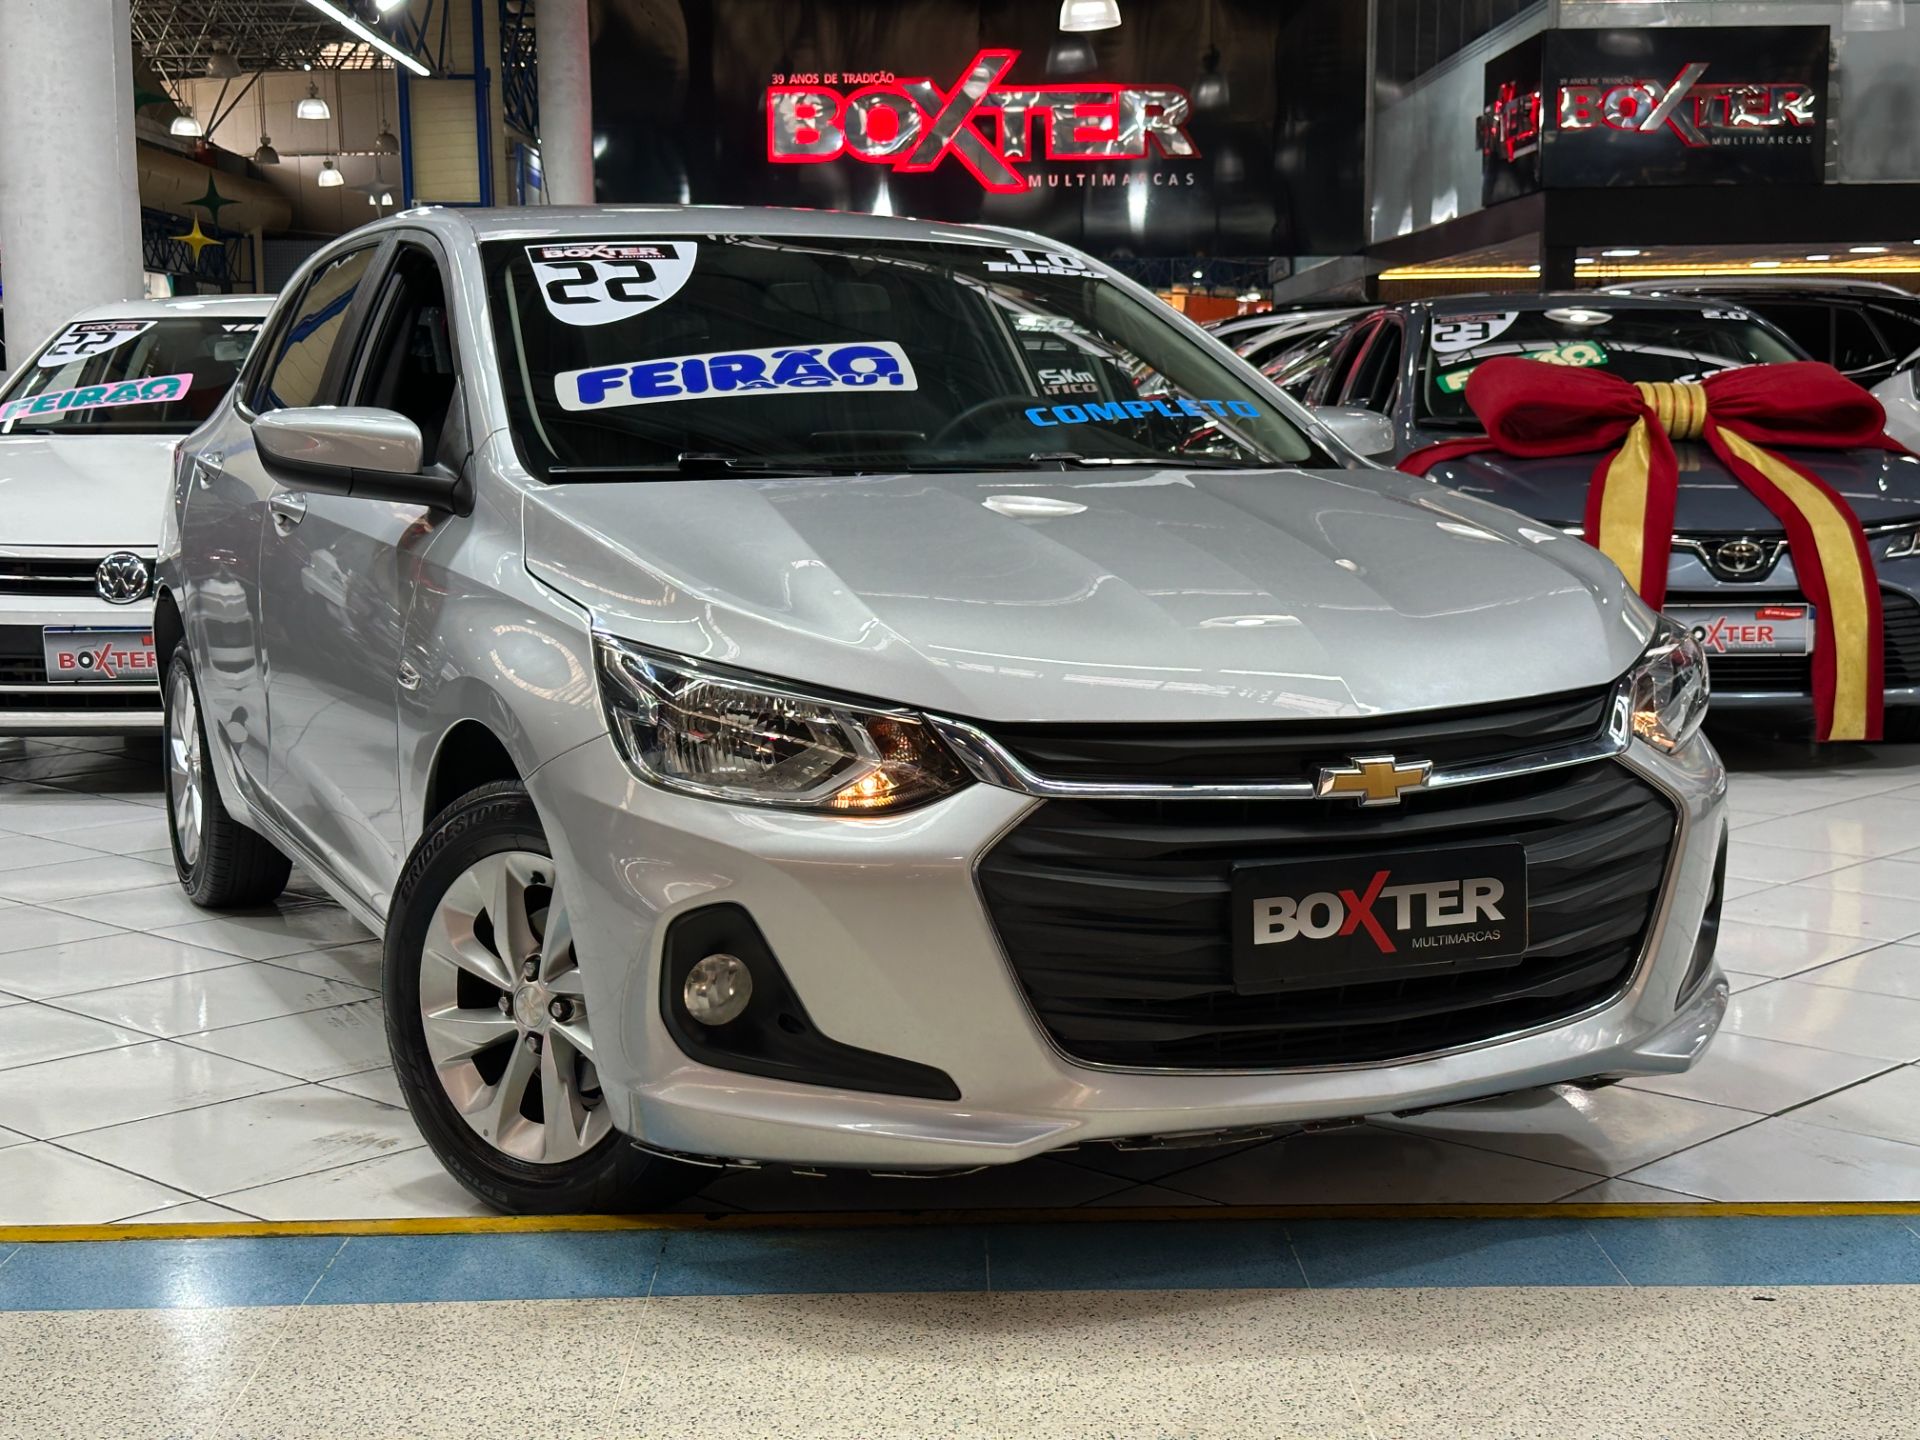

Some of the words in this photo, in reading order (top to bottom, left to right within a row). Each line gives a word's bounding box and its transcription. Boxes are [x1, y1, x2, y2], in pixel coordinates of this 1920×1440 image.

[772, 73, 785, 85] 39
[789, 73, 819, 85] ANOS
[824, 73, 838, 85] DE
[842, 70, 895, 86] TRADIÇÃO
[1557, 62, 1816, 147] BOXTER
[767, 48, 1202, 194] BOXTER
[1711, 135, 1813, 146] MULTIMARCAS
[1028, 173, 1196, 188] MULTIMARCAS
[542, 245, 662, 259] BOXTER
[1005, 249, 1087, 270] 1.0
[543, 260, 661, 305] 22
[1701, 307, 1748, 320] 2.0
[80, 323, 139, 331] BOXTER
[1435, 322, 1490, 343] 23
[47, 331, 117, 356] 22
[576, 345, 900, 404] FEIRÃO
[3, 377, 182, 420] FEIRÃO
[1024, 399, 1261, 427] COMPLETO
[1691, 615, 1775, 653] OXTER
[1253, 870, 1506, 954] BOXTER
[1411, 929, 1501, 949] MULTIMARCAS
